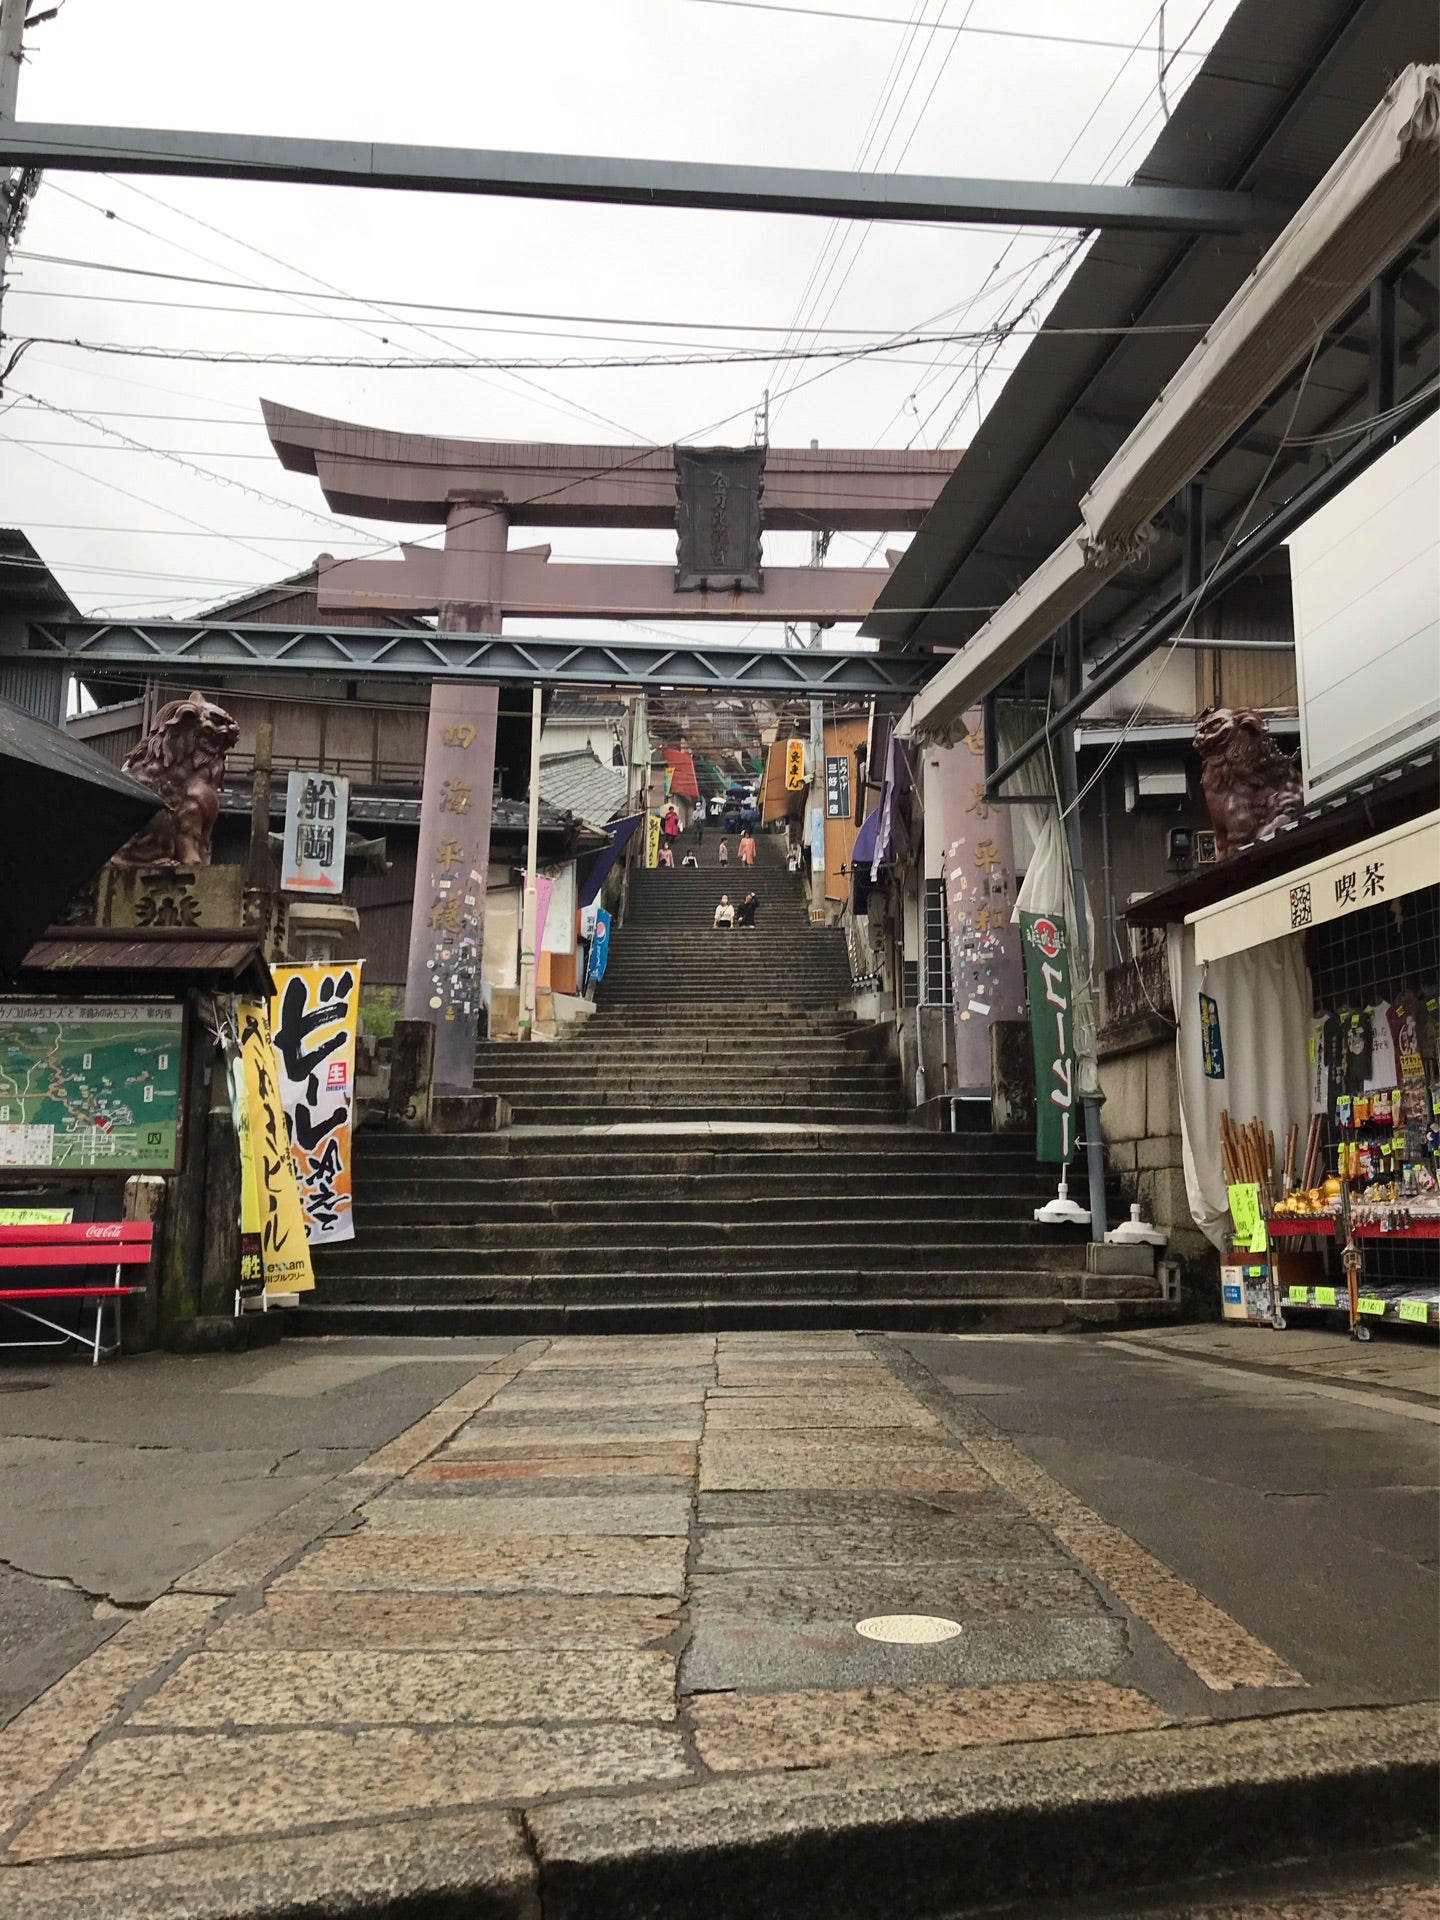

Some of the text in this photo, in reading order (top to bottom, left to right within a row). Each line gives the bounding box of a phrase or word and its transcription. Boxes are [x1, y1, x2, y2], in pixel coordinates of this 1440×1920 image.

[788, 750, 801, 788] 灸まん
[828, 763, 839, 815] 三好商店
[296, 778, 337, 867] 船岡
[1334, 862, 1385, 908] 喫茶
[273, 969, 354, 1150] ビール
[329, 1063, 347, 1085] 生
[85, 1224, 124, 1239] Coca-Cola
